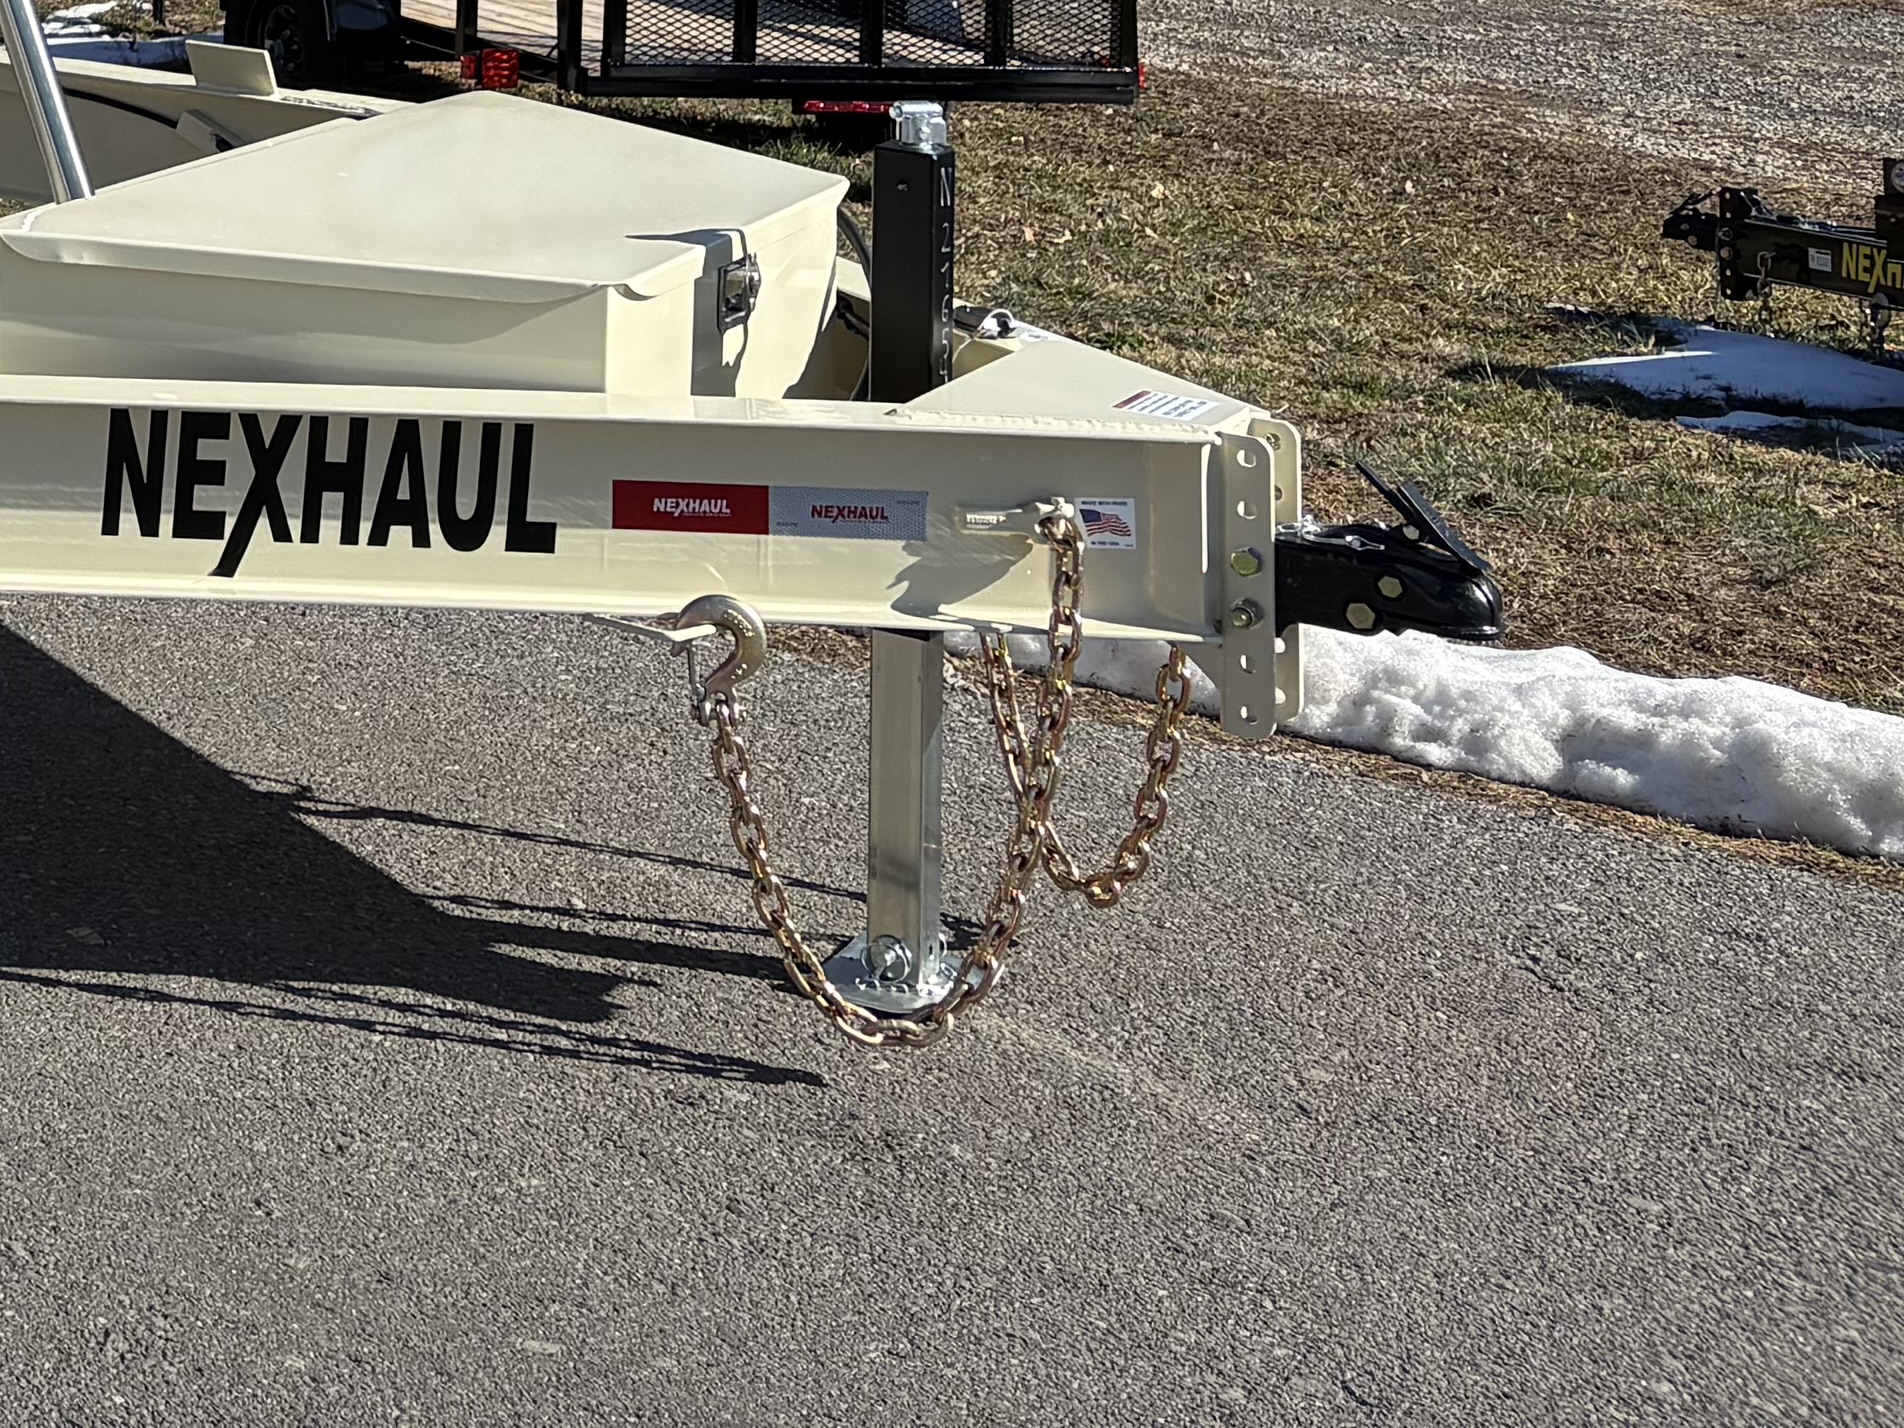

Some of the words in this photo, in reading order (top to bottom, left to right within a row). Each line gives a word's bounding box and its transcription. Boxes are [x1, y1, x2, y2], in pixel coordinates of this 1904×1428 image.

[100, 407, 557, 578] NEXHAUL
[653, 497, 731, 517] NEXHAUL
[810, 504, 889, 524] NEXHAUL
